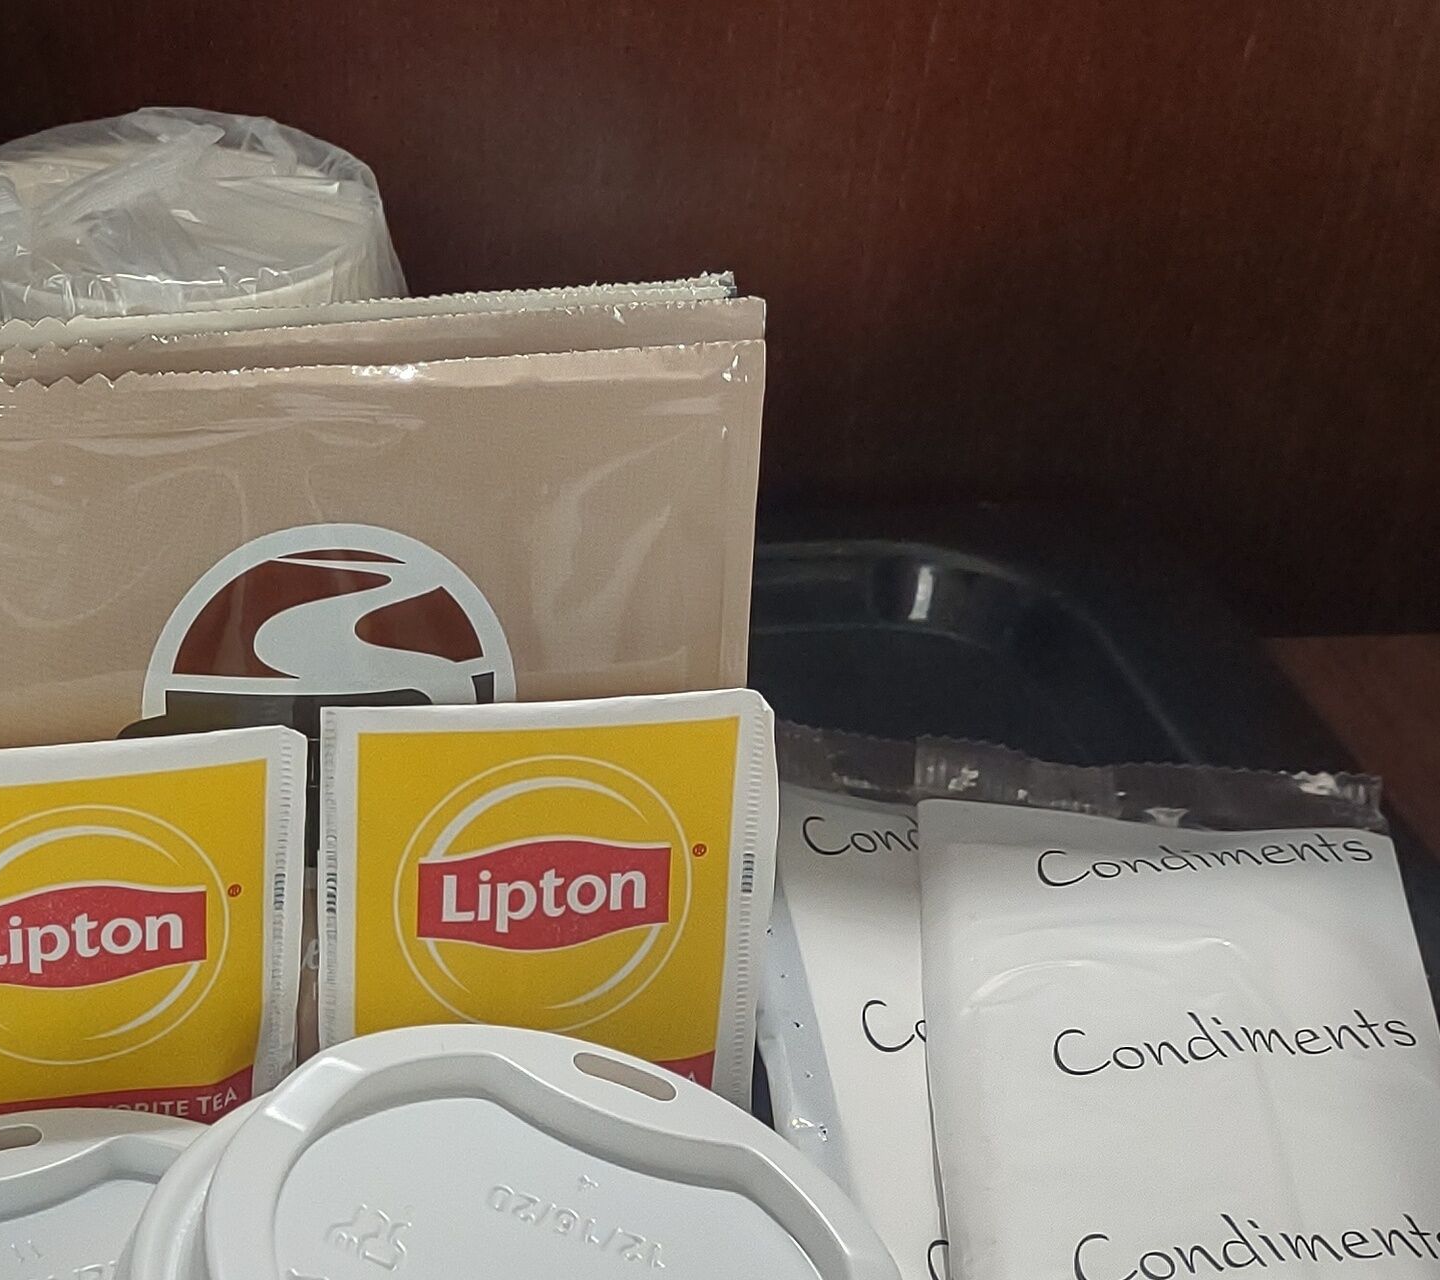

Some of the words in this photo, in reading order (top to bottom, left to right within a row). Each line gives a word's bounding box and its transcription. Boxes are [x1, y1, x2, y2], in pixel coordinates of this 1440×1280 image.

[1037, 833, 1374, 887] Condiments
[441, 868, 647, 934] Lipton
[1053, 1009, 1419, 1076] Condiments
[196, 1086, 239, 1116] TEA
